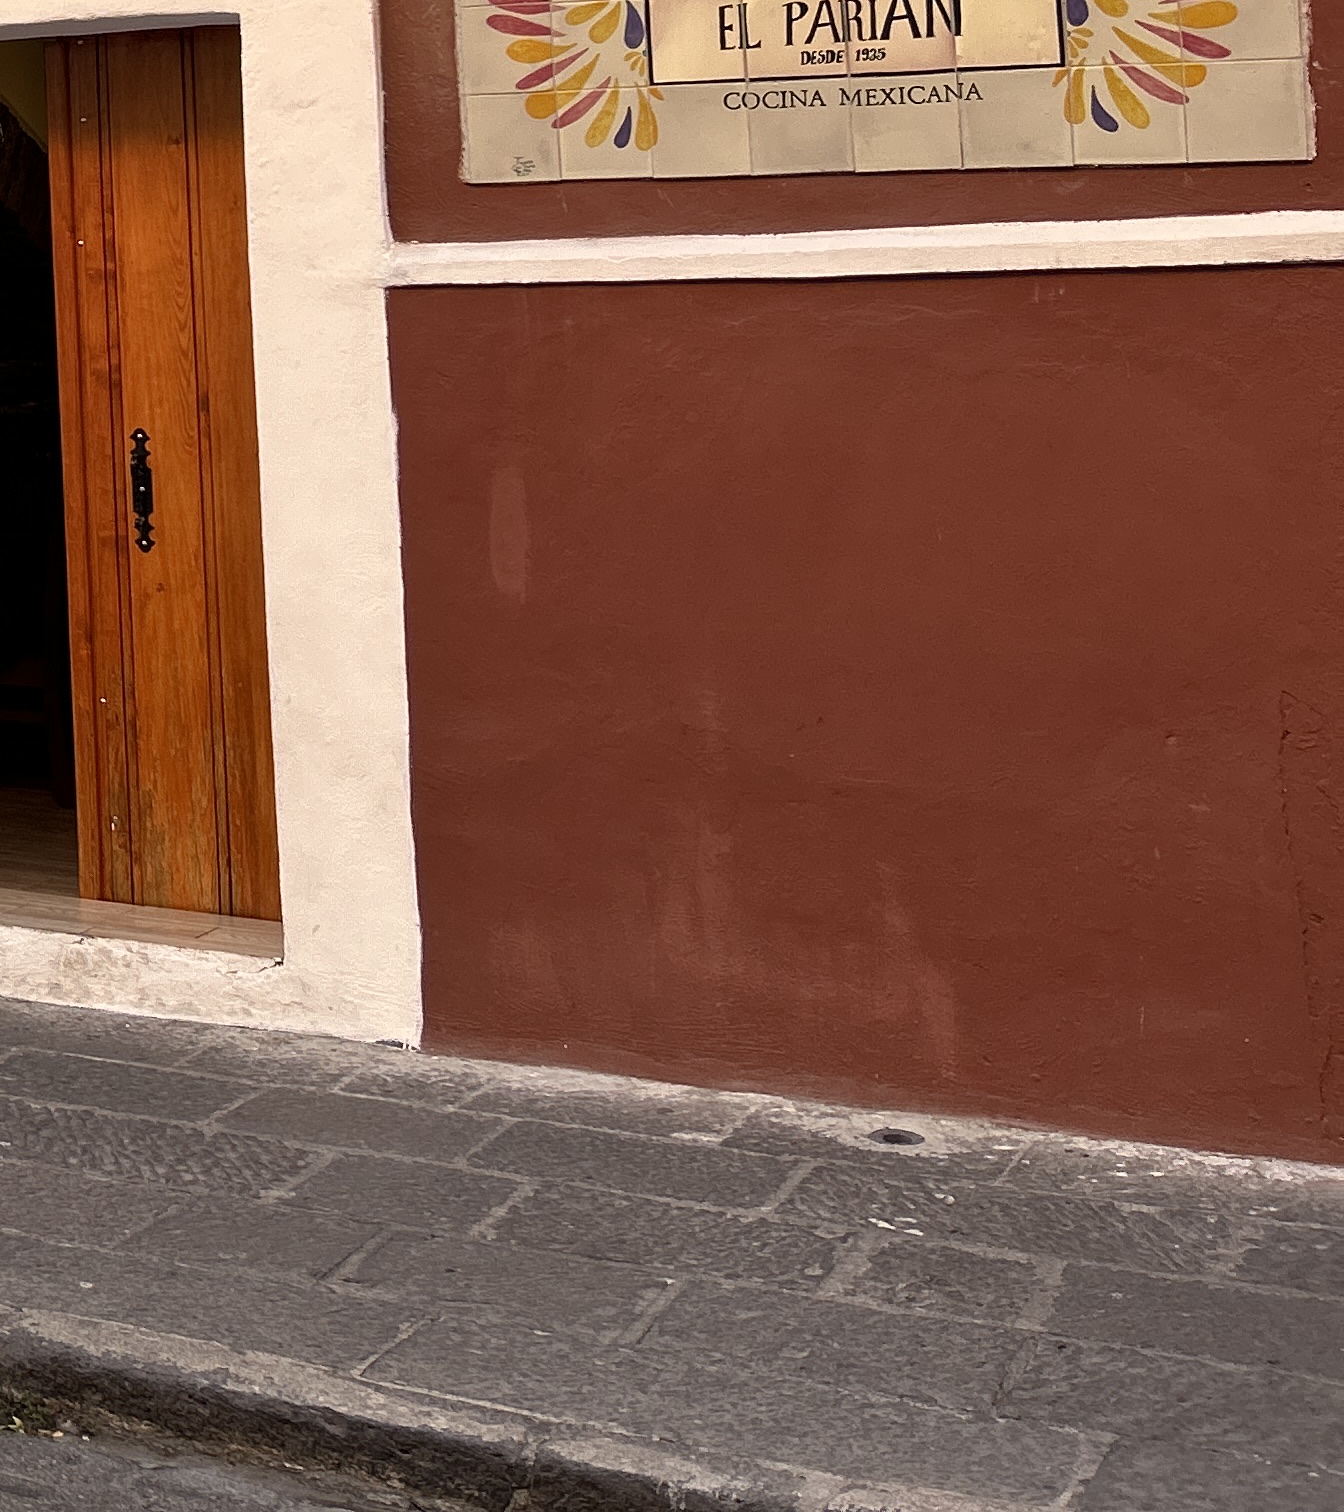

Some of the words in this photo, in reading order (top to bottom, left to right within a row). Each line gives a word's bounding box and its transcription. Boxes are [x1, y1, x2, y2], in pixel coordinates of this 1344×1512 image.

[718, 2, 762, 51] EL
[800, 49, 845, 65] DESDE
[723, 88, 827, 111] COCINA
[839, 82, 984, 107] MEXICANA
